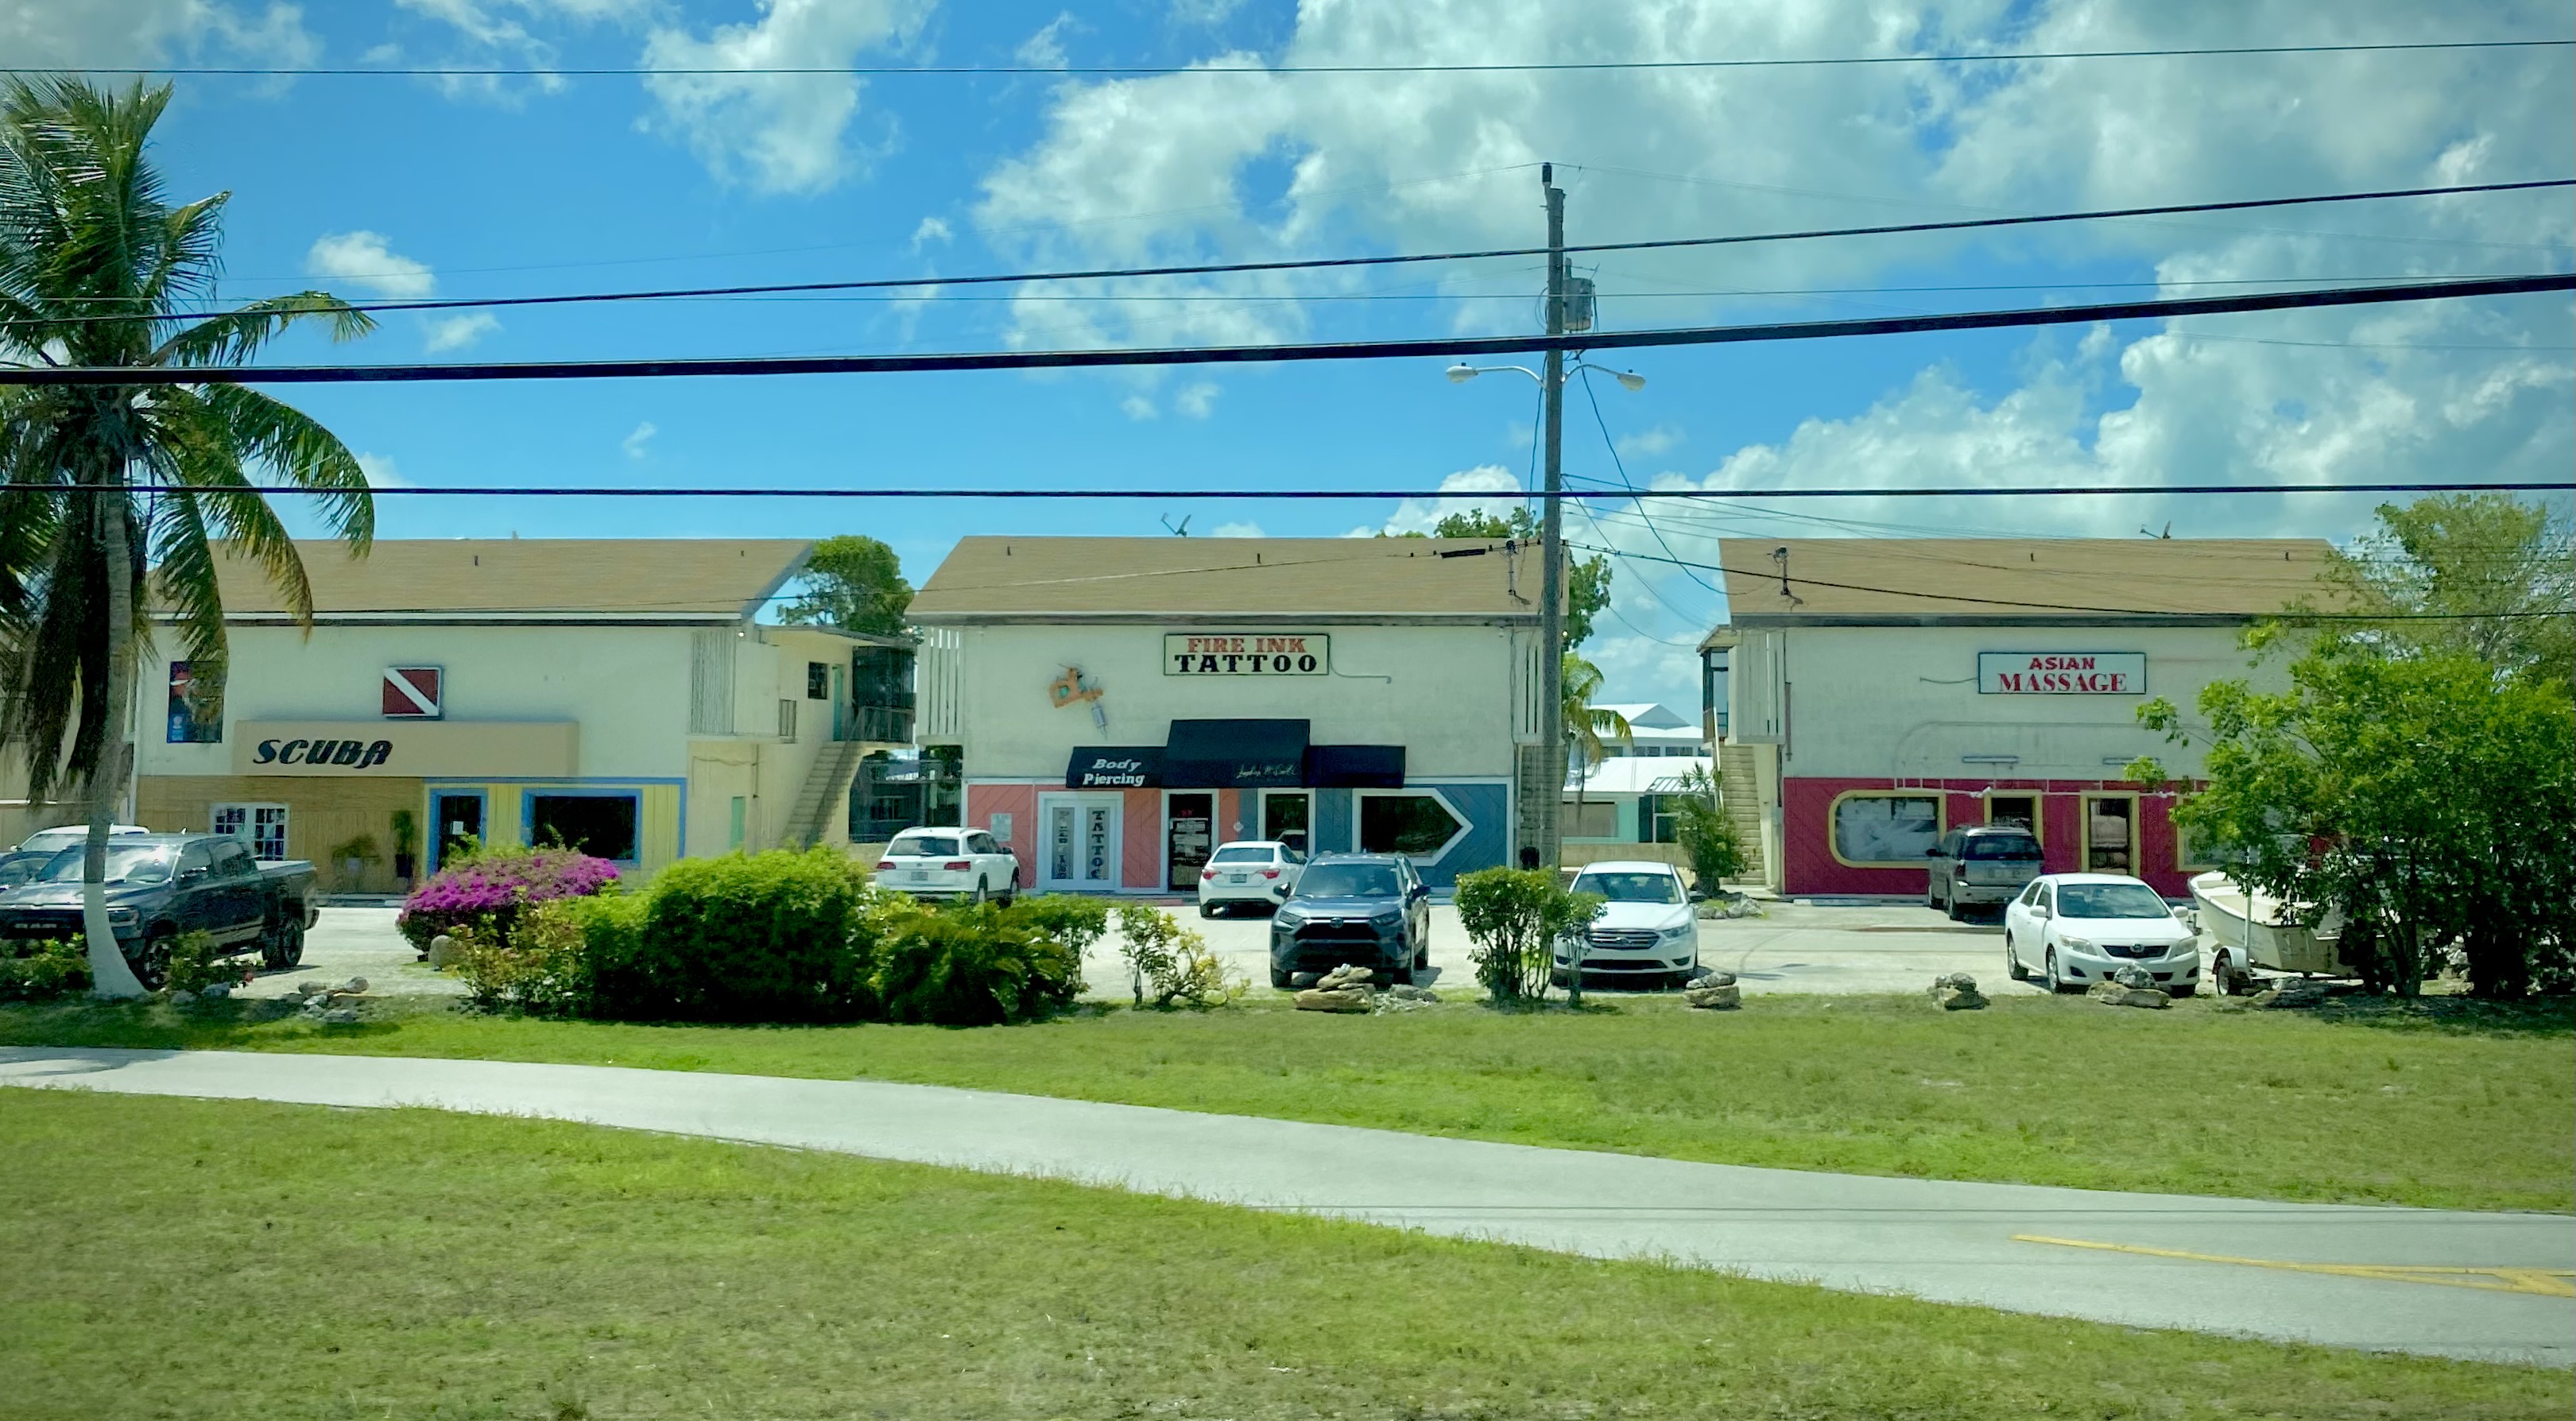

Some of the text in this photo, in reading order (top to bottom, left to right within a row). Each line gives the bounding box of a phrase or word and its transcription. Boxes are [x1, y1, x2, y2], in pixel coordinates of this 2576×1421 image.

[1187, 637, 1306, 652] FIRE INK
[1175, 654, 1317, 672] TATTOO
[2028, 656, 2095, 670] ASIAN
[1998, 673, 2126, 691] MASSAGE
[253, 739, 393, 769] SCUBA
[1092, 758, 1141, 772] Body
[1083, 772, 1145, 787] Piercing
